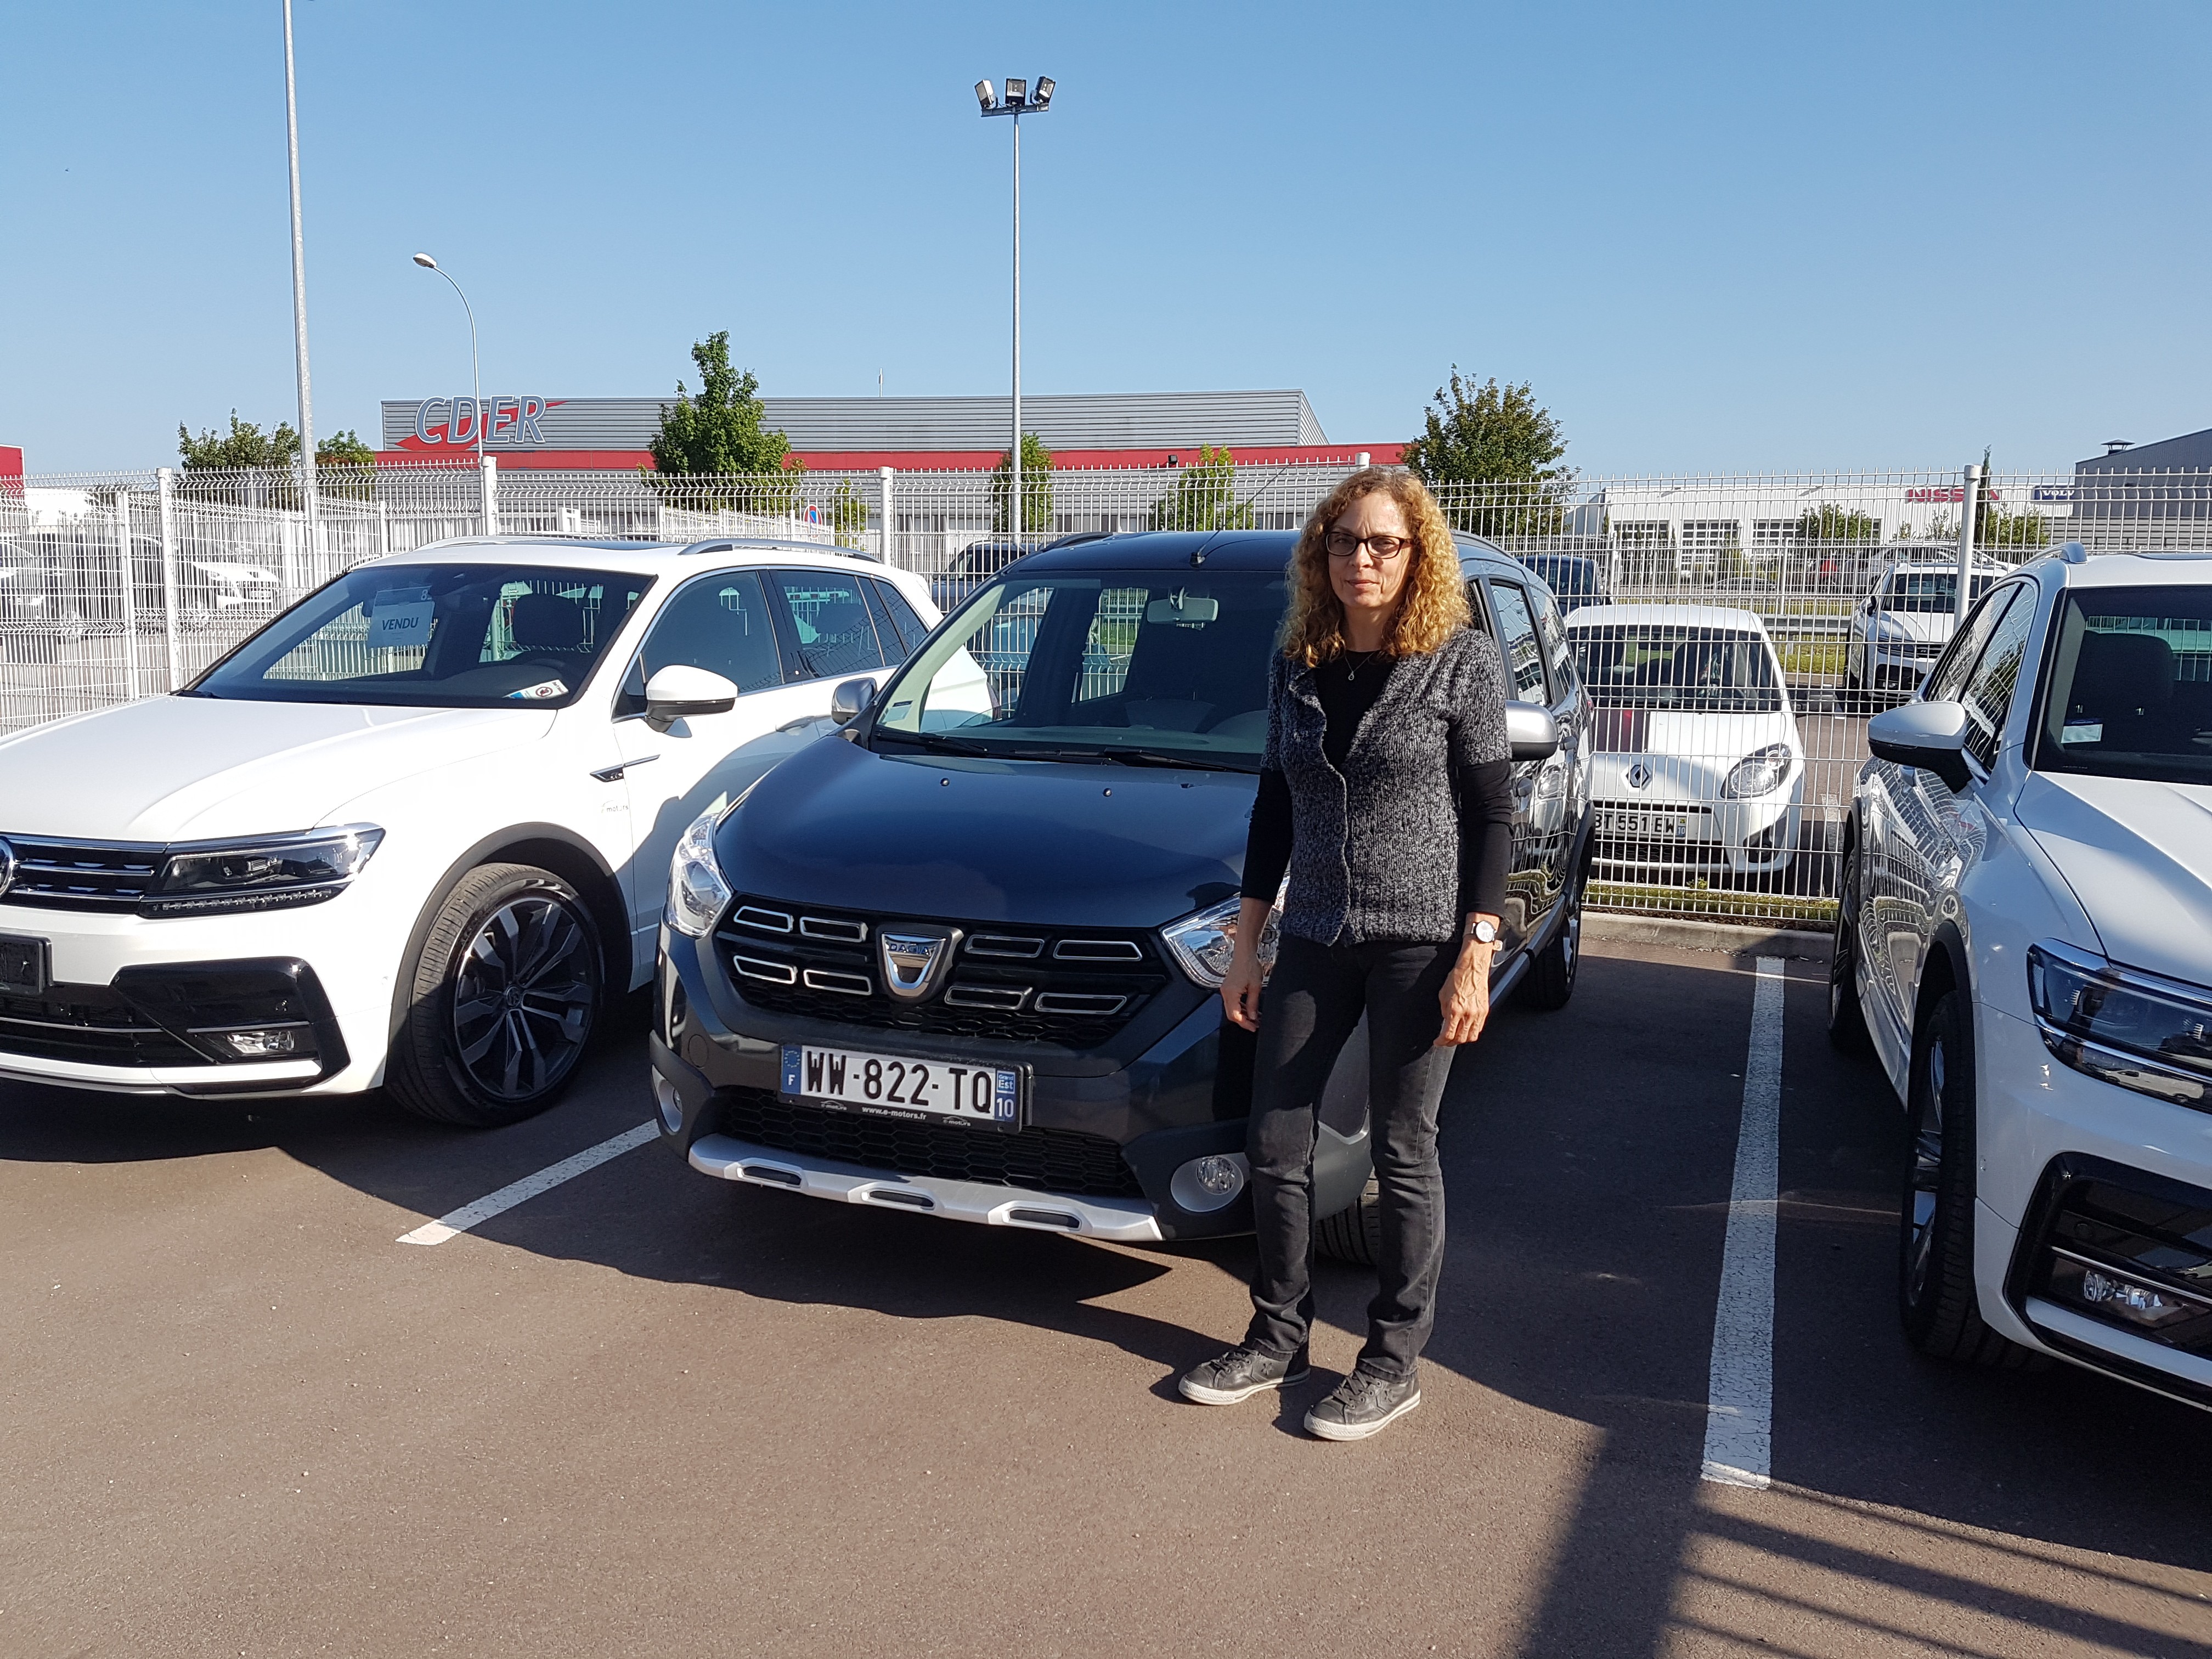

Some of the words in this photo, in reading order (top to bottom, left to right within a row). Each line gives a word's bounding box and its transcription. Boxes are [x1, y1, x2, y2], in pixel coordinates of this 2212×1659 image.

[415, 395, 546, 443] CDER
[382, 617, 419, 630] VENDU
[890, 944, 931, 956] DACIA
[788, 1074, 795, 1086] F
[998, 1079, 1013, 1090] Est
[862, 1107, 927, 1120] www.e-motors.fr
[996, 1097, 1014, 1118] 10
